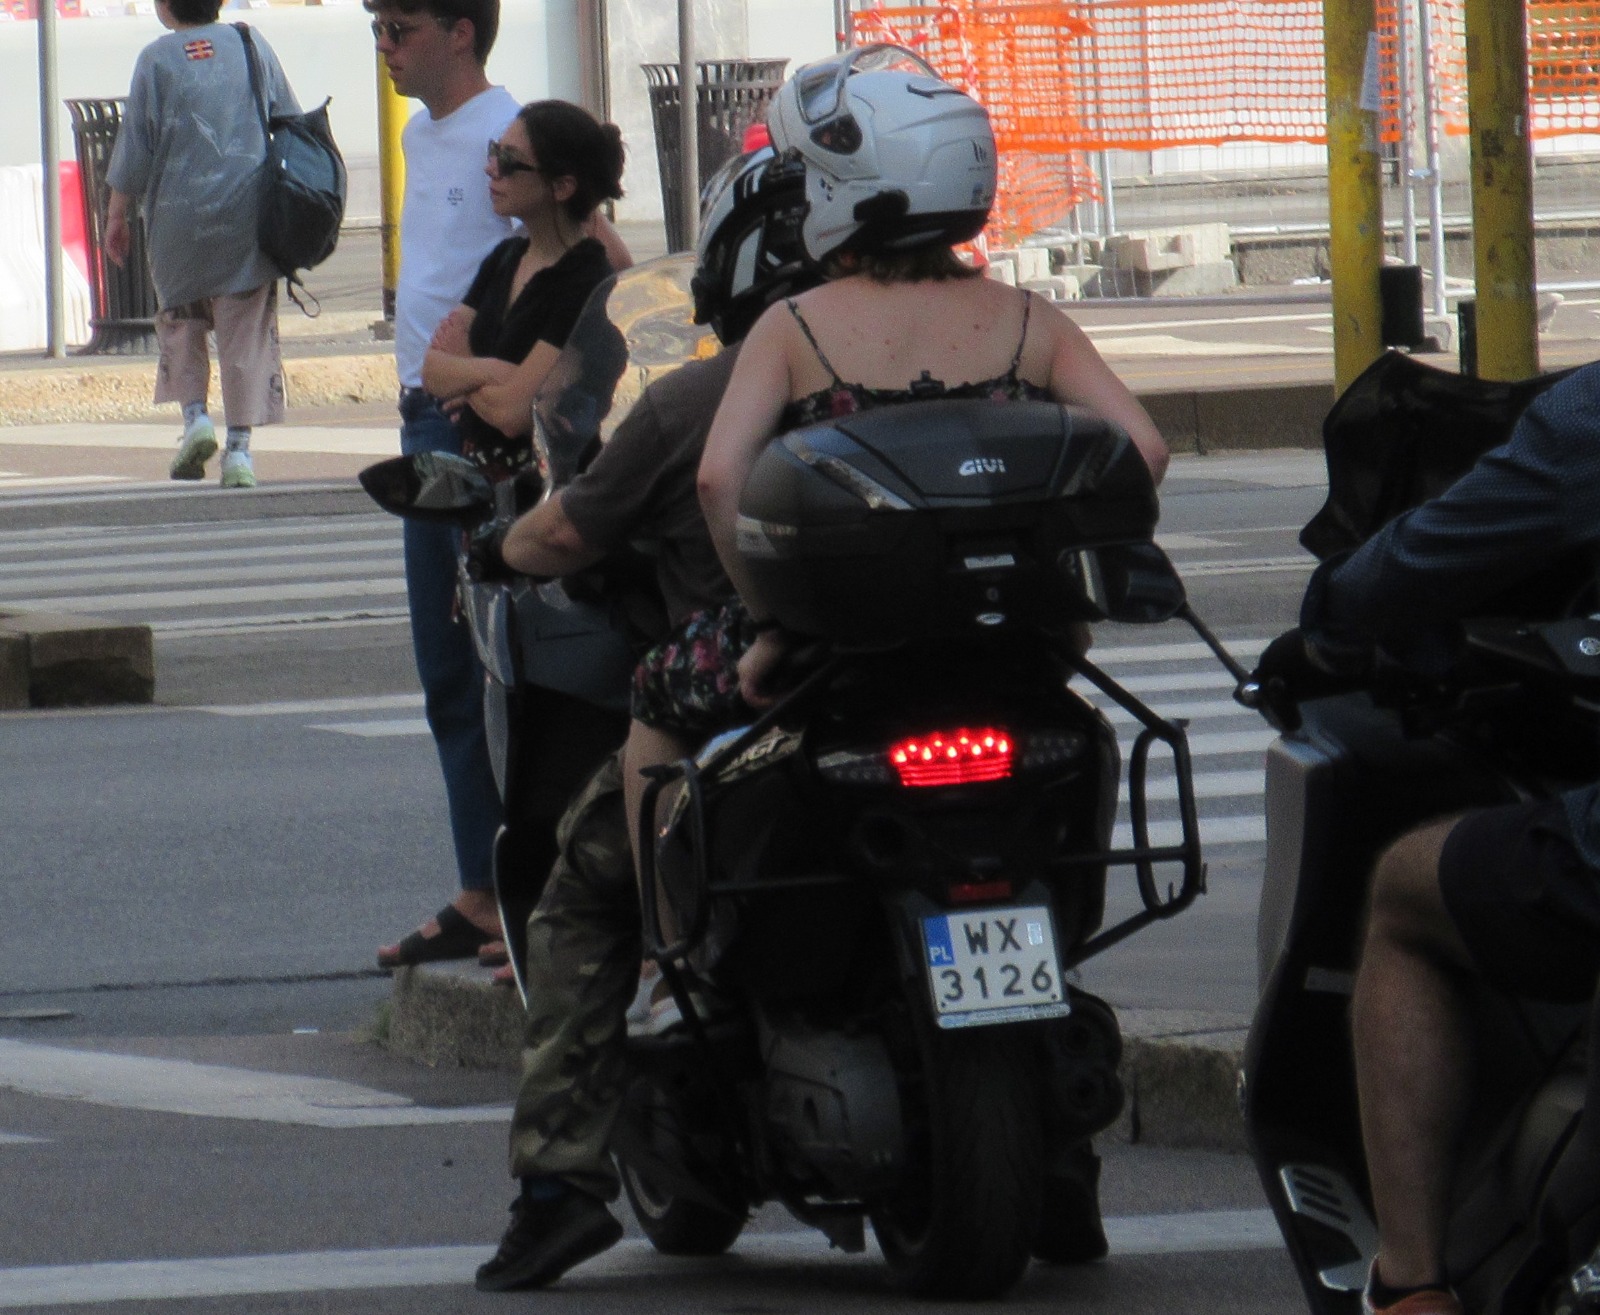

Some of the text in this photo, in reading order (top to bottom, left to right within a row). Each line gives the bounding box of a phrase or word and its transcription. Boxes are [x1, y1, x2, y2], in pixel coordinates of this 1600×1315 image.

[958, 458, 1006, 476] GIVI
[963, 918, 1023, 955] WX
[929, 946, 953, 963] PL
[940, 960, 1053, 1001] 3126
